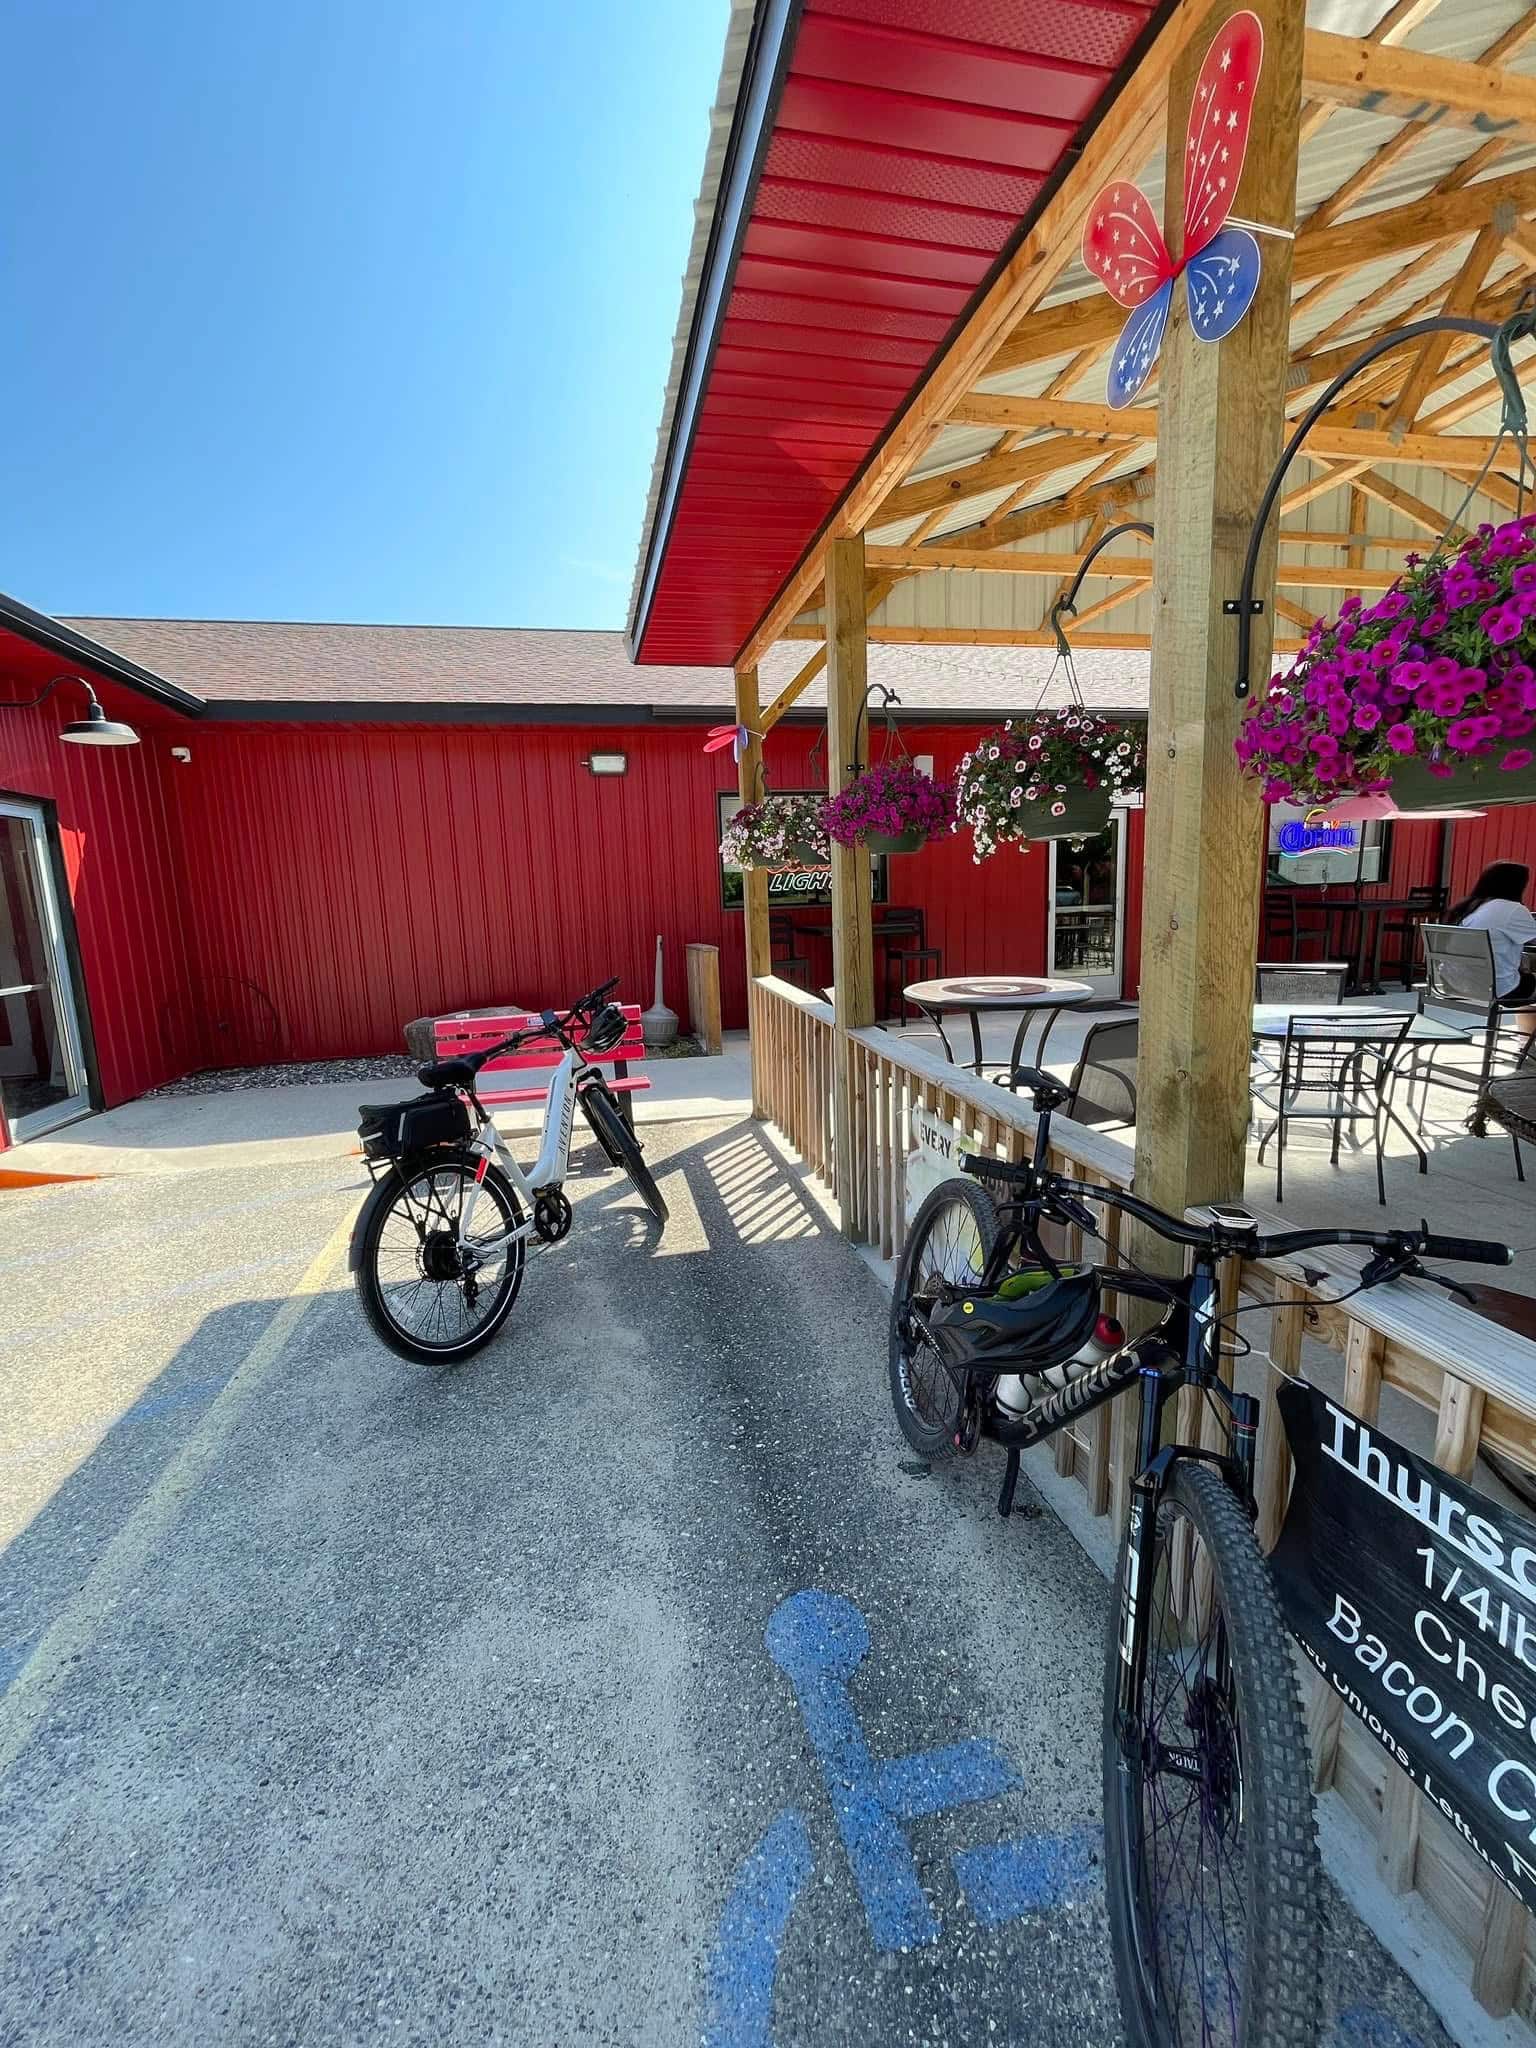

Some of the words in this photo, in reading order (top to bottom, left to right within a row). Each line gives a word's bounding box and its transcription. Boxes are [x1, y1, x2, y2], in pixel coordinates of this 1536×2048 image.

[1280, 821, 1354, 851] Corona
[559, 1094, 572, 1155] AVENTON
[920, 1120, 951, 1159] EVERY
[1326, 1593, 1475, 1760] Bacon
[1414, 1610, 1536, 1748] Che
